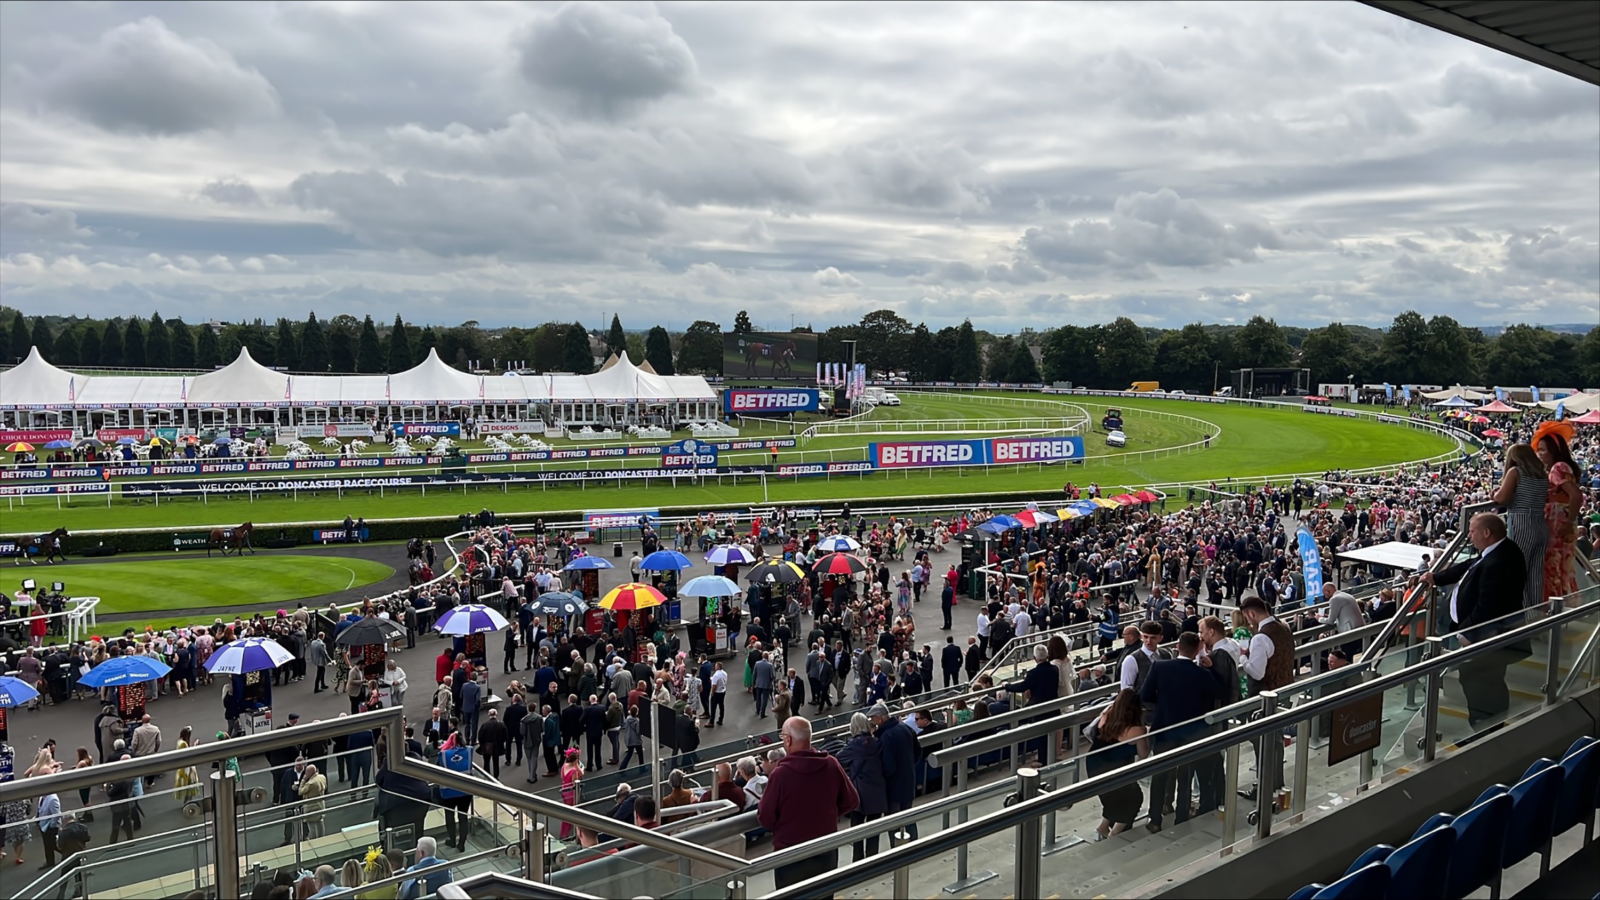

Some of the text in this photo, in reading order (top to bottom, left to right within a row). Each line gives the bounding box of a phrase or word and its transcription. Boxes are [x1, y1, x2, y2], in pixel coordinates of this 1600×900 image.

[734, 392, 810, 408] BETFRED
[470, 454, 507, 462] BETFRED
[511, 452, 547, 460] BETFRED
[733, 441, 762, 449] BETFRED
[882, 440, 1074, 464] BETFRED BETFRED
[1, 470, 47, 479] BETFRED
[52, 469, 98, 477] BETFRED
[153, 466, 196, 474] BETFRED
[202, 464, 244, 472] BETFRED
[249, 462, 290, 470] BETFRED
[296, 461, 336, 469] BETFRED
[340, 459, 380, 467] BETFRED
[538, 468, 717, 480] WELCOME TO DONCASTER RACECORSE
[780, 463, 872, 475] BETFRED BETFRED
[0, 484, 106, 494] BETFRED BETFRED
[198, 478, 412, 492] WELCOME TO DONCASTER RACECOURSE
[255, 720, 270, 728] JAYNE
